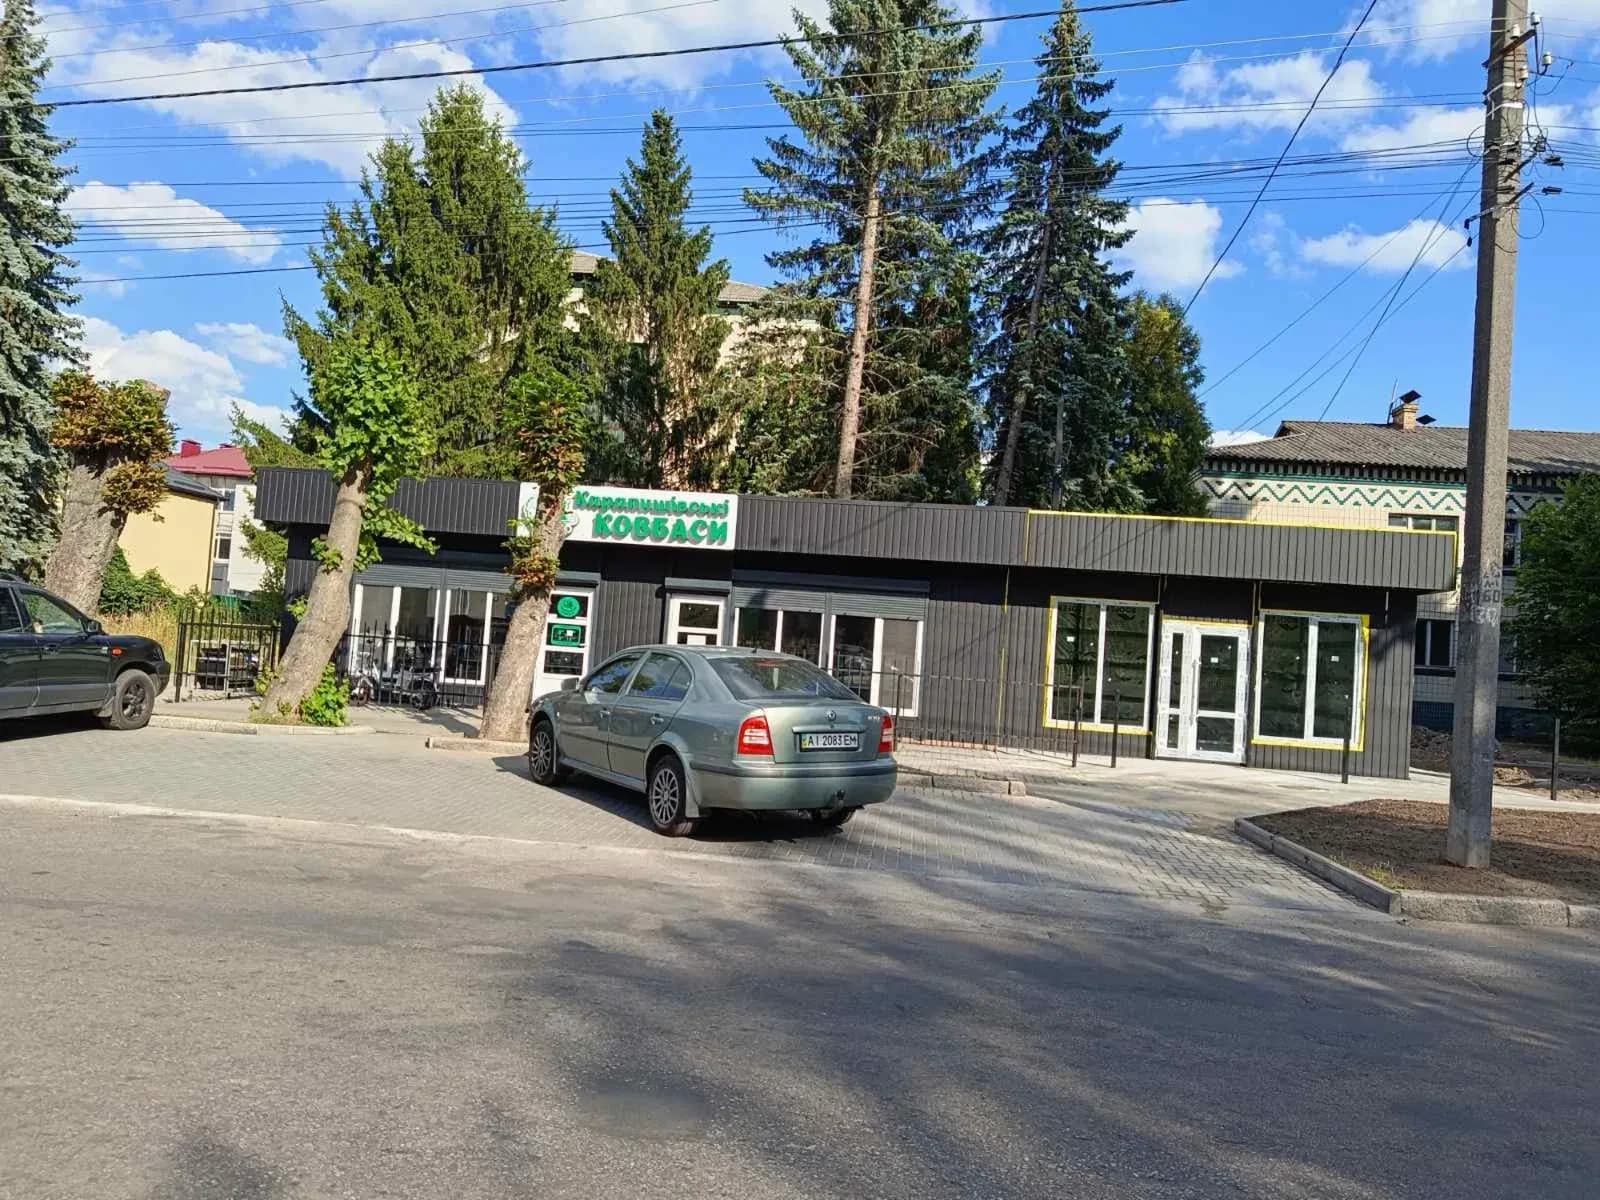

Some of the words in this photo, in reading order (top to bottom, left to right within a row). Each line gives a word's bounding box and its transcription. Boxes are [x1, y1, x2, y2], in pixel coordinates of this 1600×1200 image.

[573, 491, 730, 517] Карапишівські
[592, 513, 729, 545] КОВБАСИ
[822, 735, 843, 746] 2083
[843, 734, 857, 746] EM
